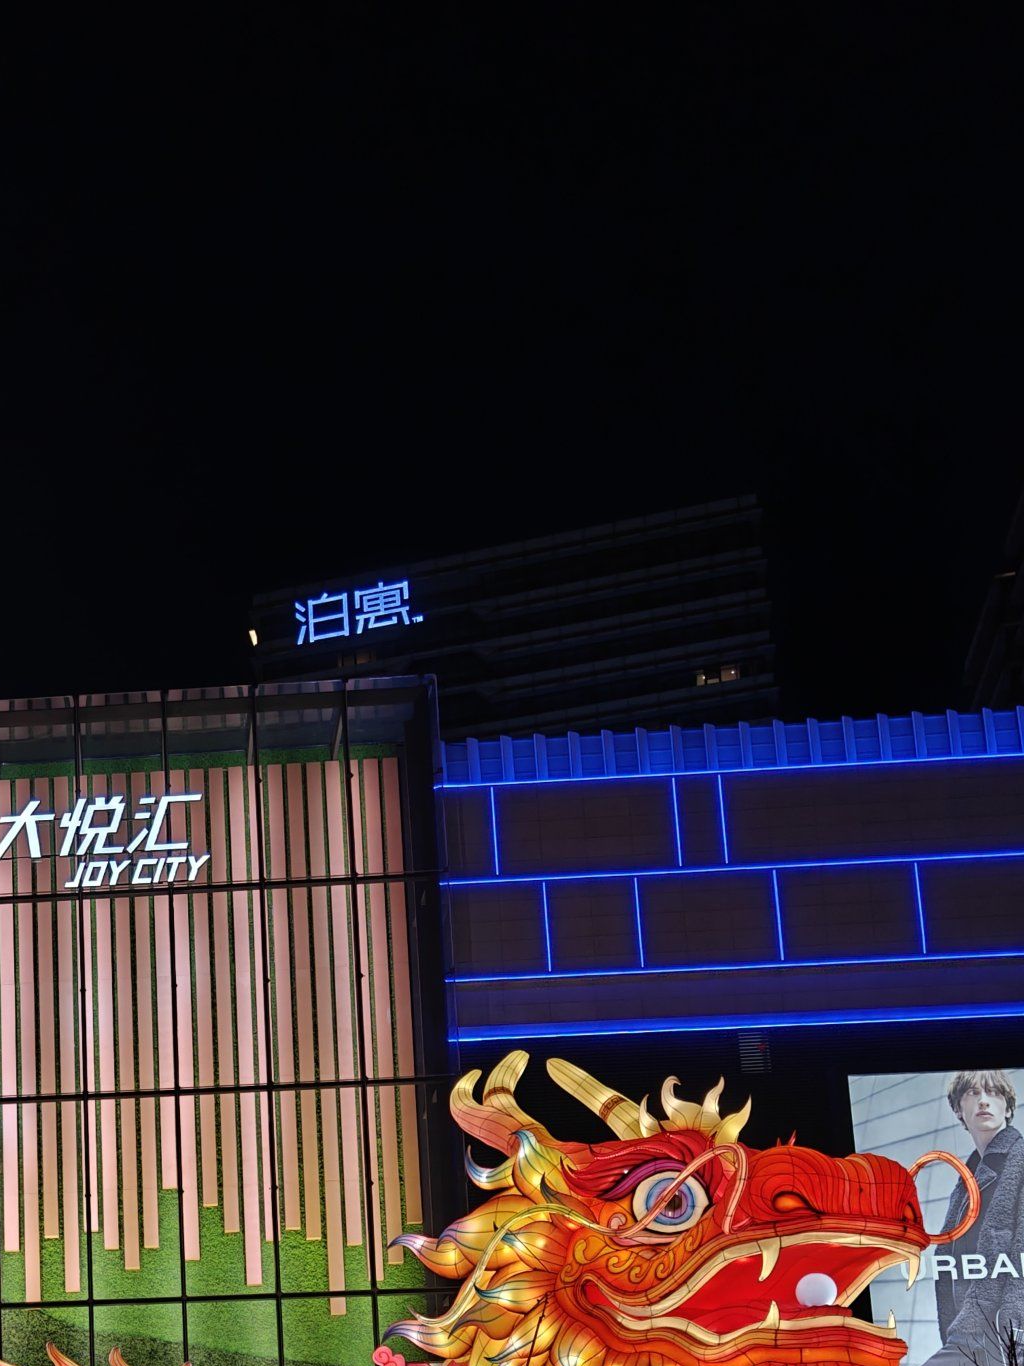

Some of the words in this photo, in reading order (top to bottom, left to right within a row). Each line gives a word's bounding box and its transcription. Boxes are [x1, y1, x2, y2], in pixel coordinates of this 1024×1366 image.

[295, 580, 410, 646] 泊寓
[64, 859, 131, 888] JOY
[131, 854, 211, 884] CITY
[900, 1252, 1024, 1281] URBA
